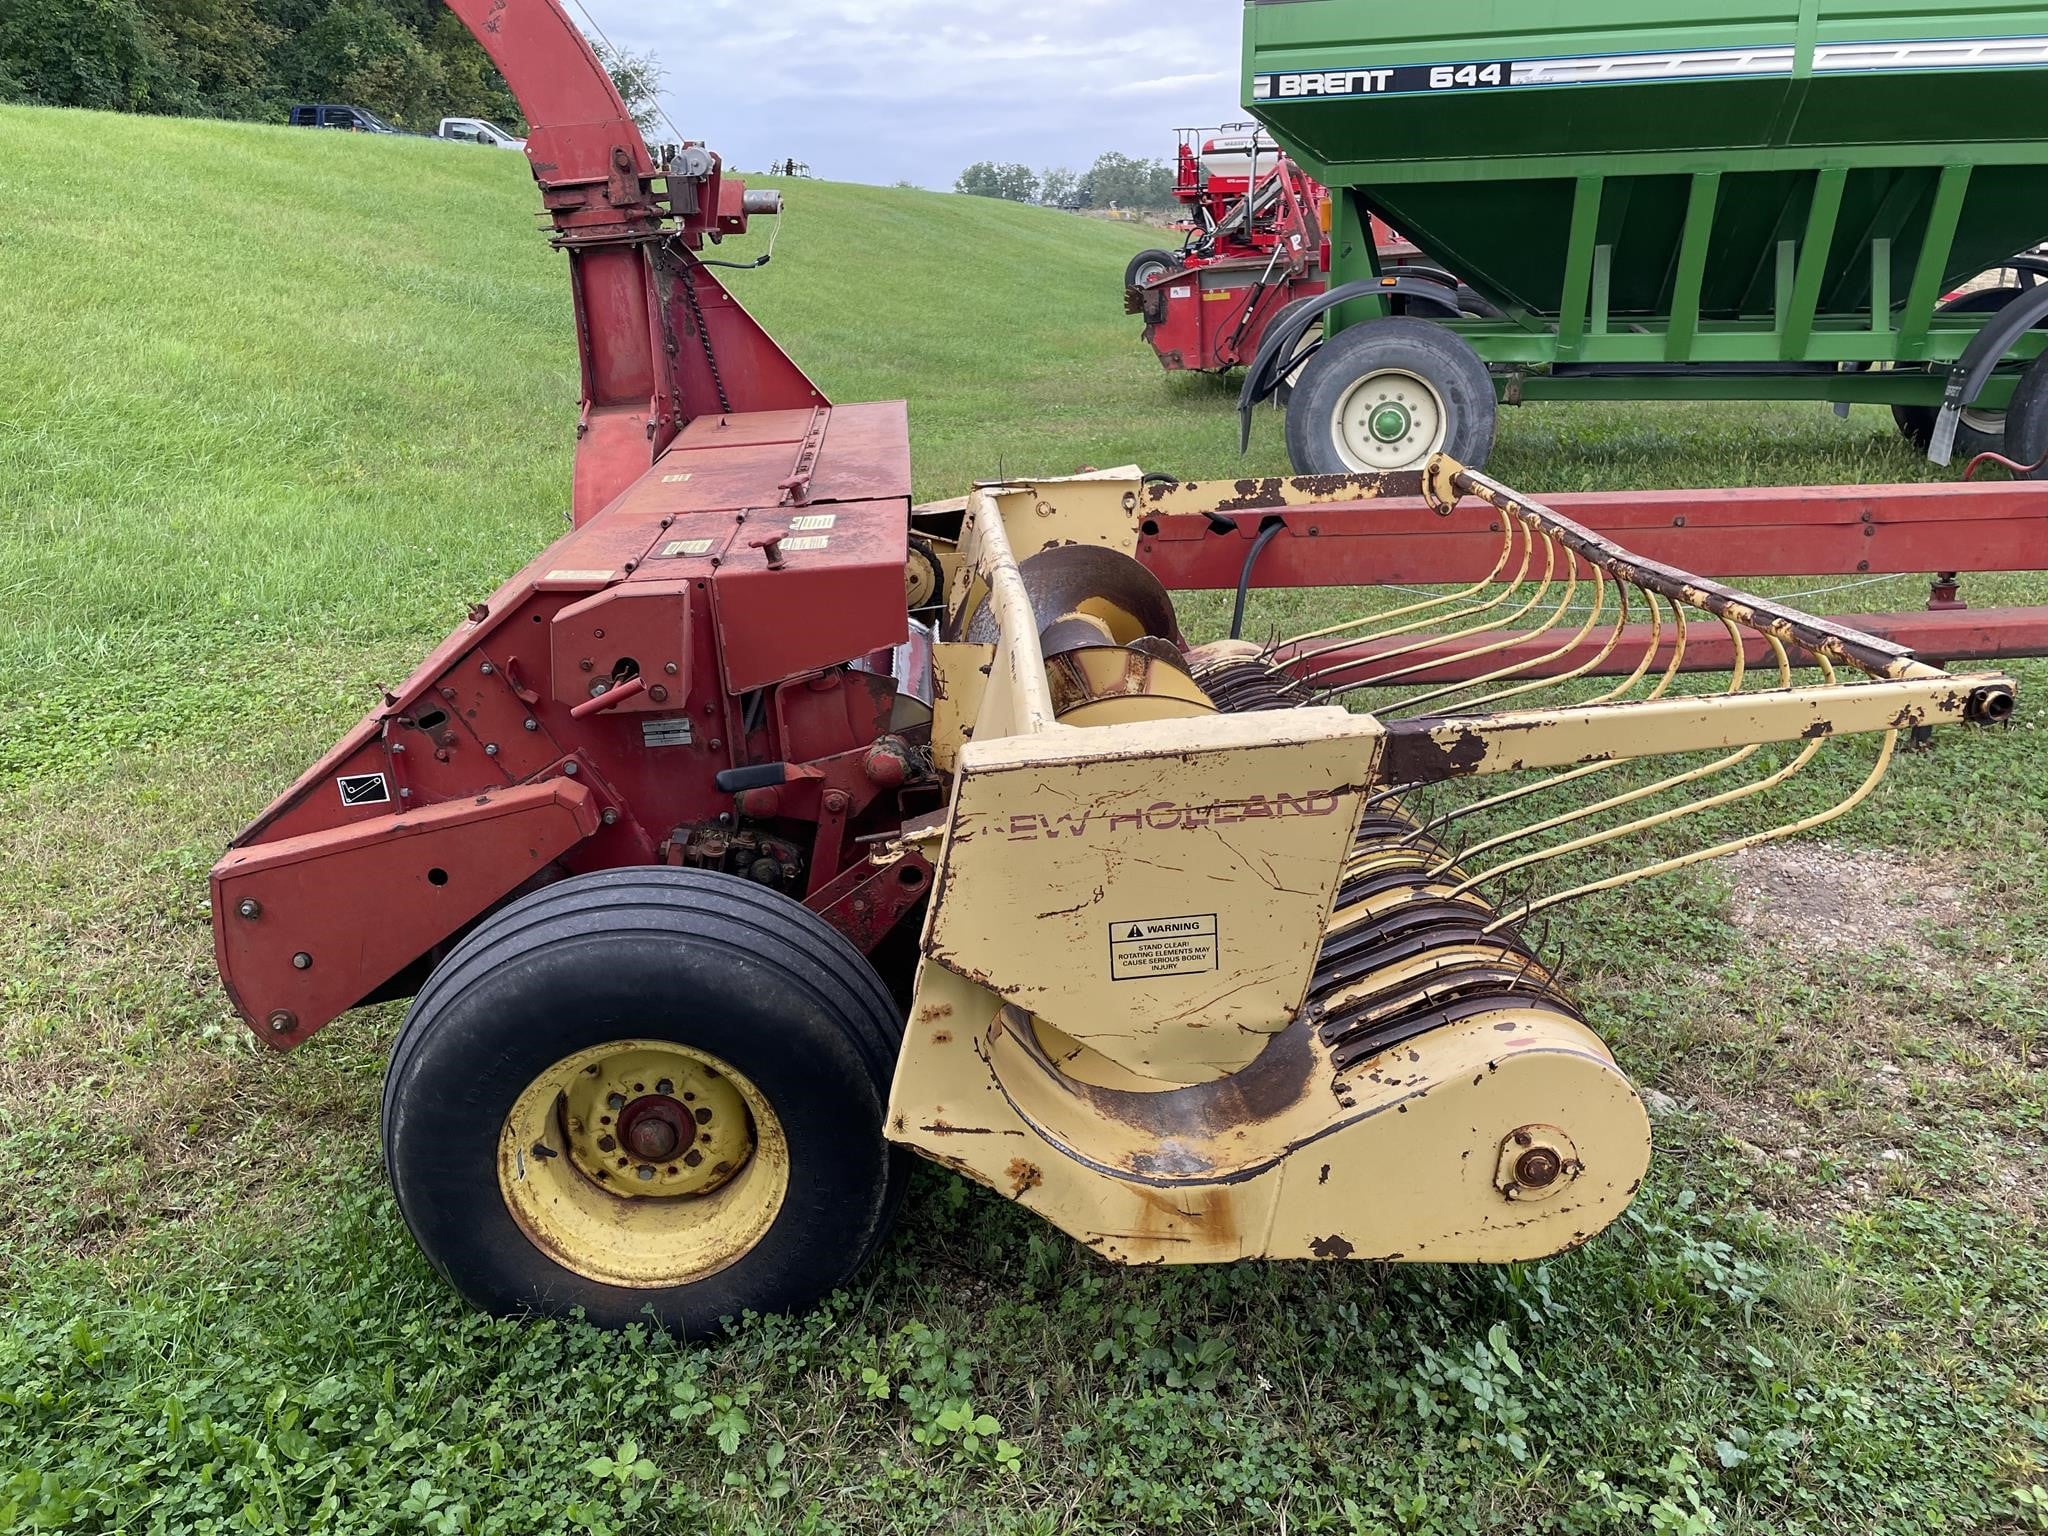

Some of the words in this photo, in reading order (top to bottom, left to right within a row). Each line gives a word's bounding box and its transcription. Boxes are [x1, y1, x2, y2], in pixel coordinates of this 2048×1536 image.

[1279, 70, 1394, 96] BRENT
[1429, 64, 1501, 89] 644
[982, 809, 1091, 841] EW
[1147, 922, 1200, 933] WARNING
[1164, 941, 1190, 949] CLEAR!
[1118, 951, 1153, 960] ROTATING
[1155, 948, 1193, 956] ELEMENTS
[1149, 956, 1180, 965] SERIOUS
[1151, 963, 1178, 971] INJURY
